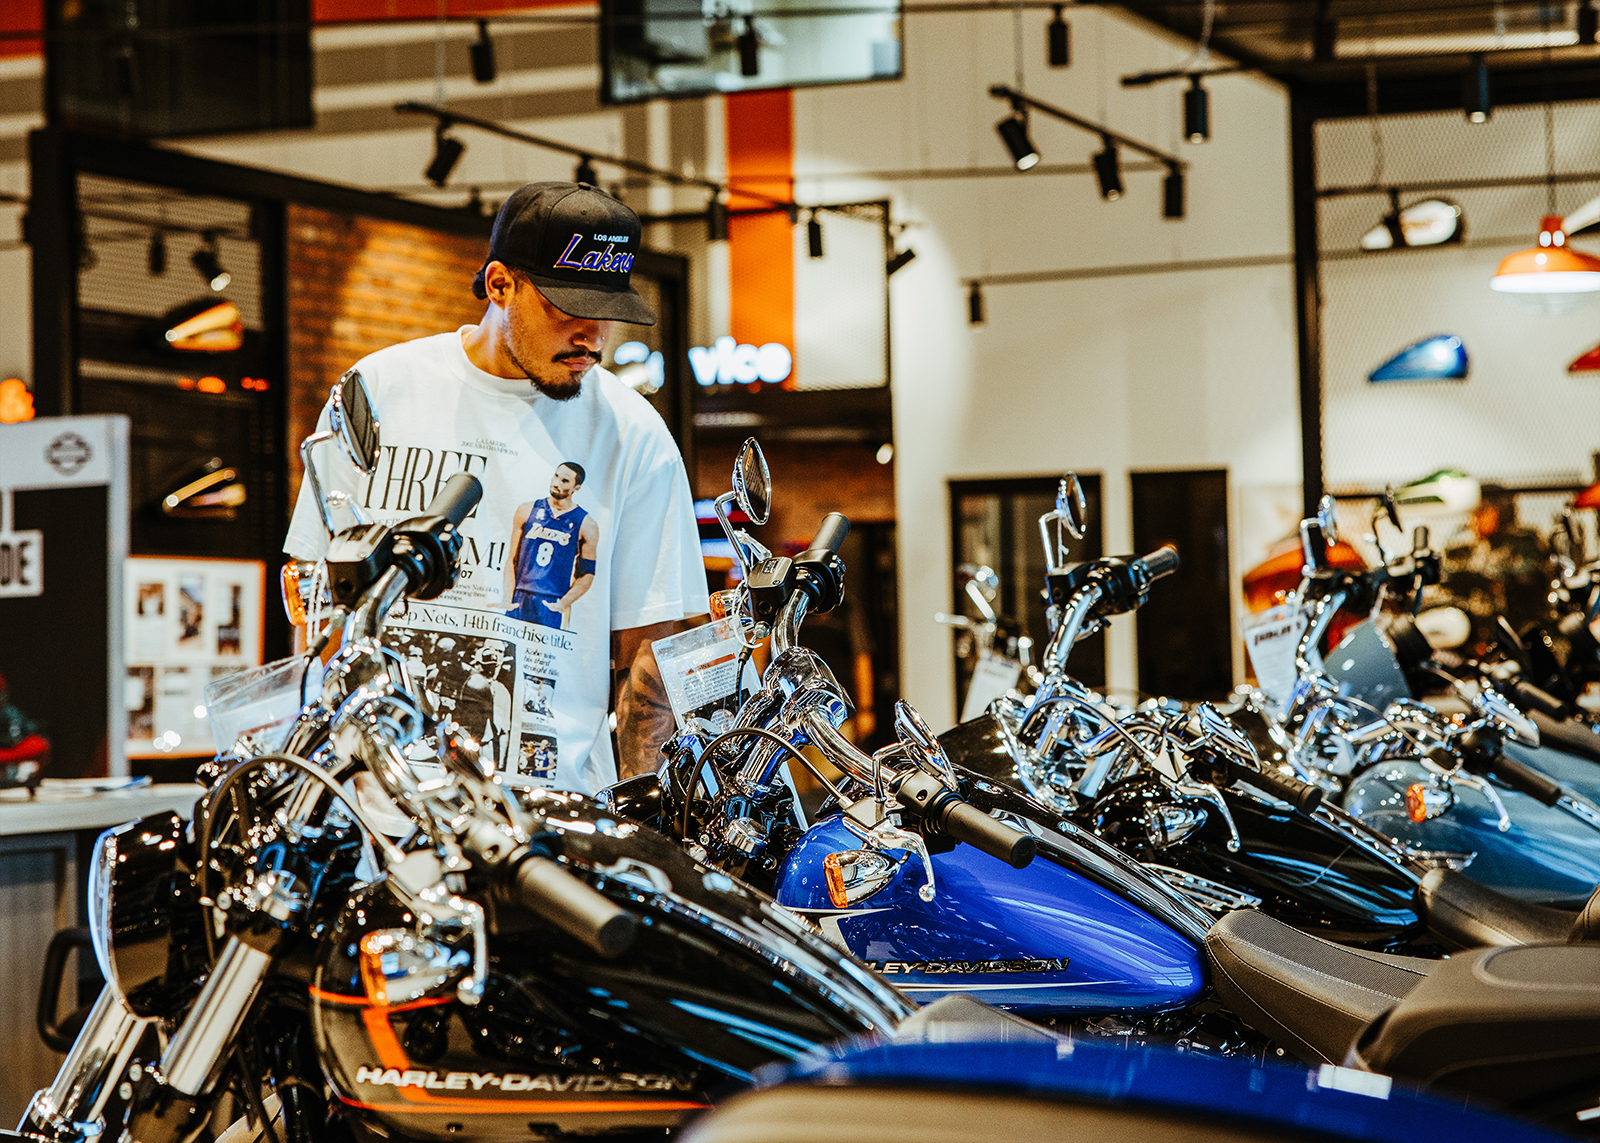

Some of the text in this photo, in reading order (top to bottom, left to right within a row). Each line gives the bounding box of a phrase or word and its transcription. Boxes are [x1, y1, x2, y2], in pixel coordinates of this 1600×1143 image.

[593, 233, 607, 242] LOS
[536, 542, 554, 567] 8
[463, 614, 489, 632] 14th
[492, 618, 549, 645] franchise
[863, 958, 1071, 974] LEY-DAVIDSON
